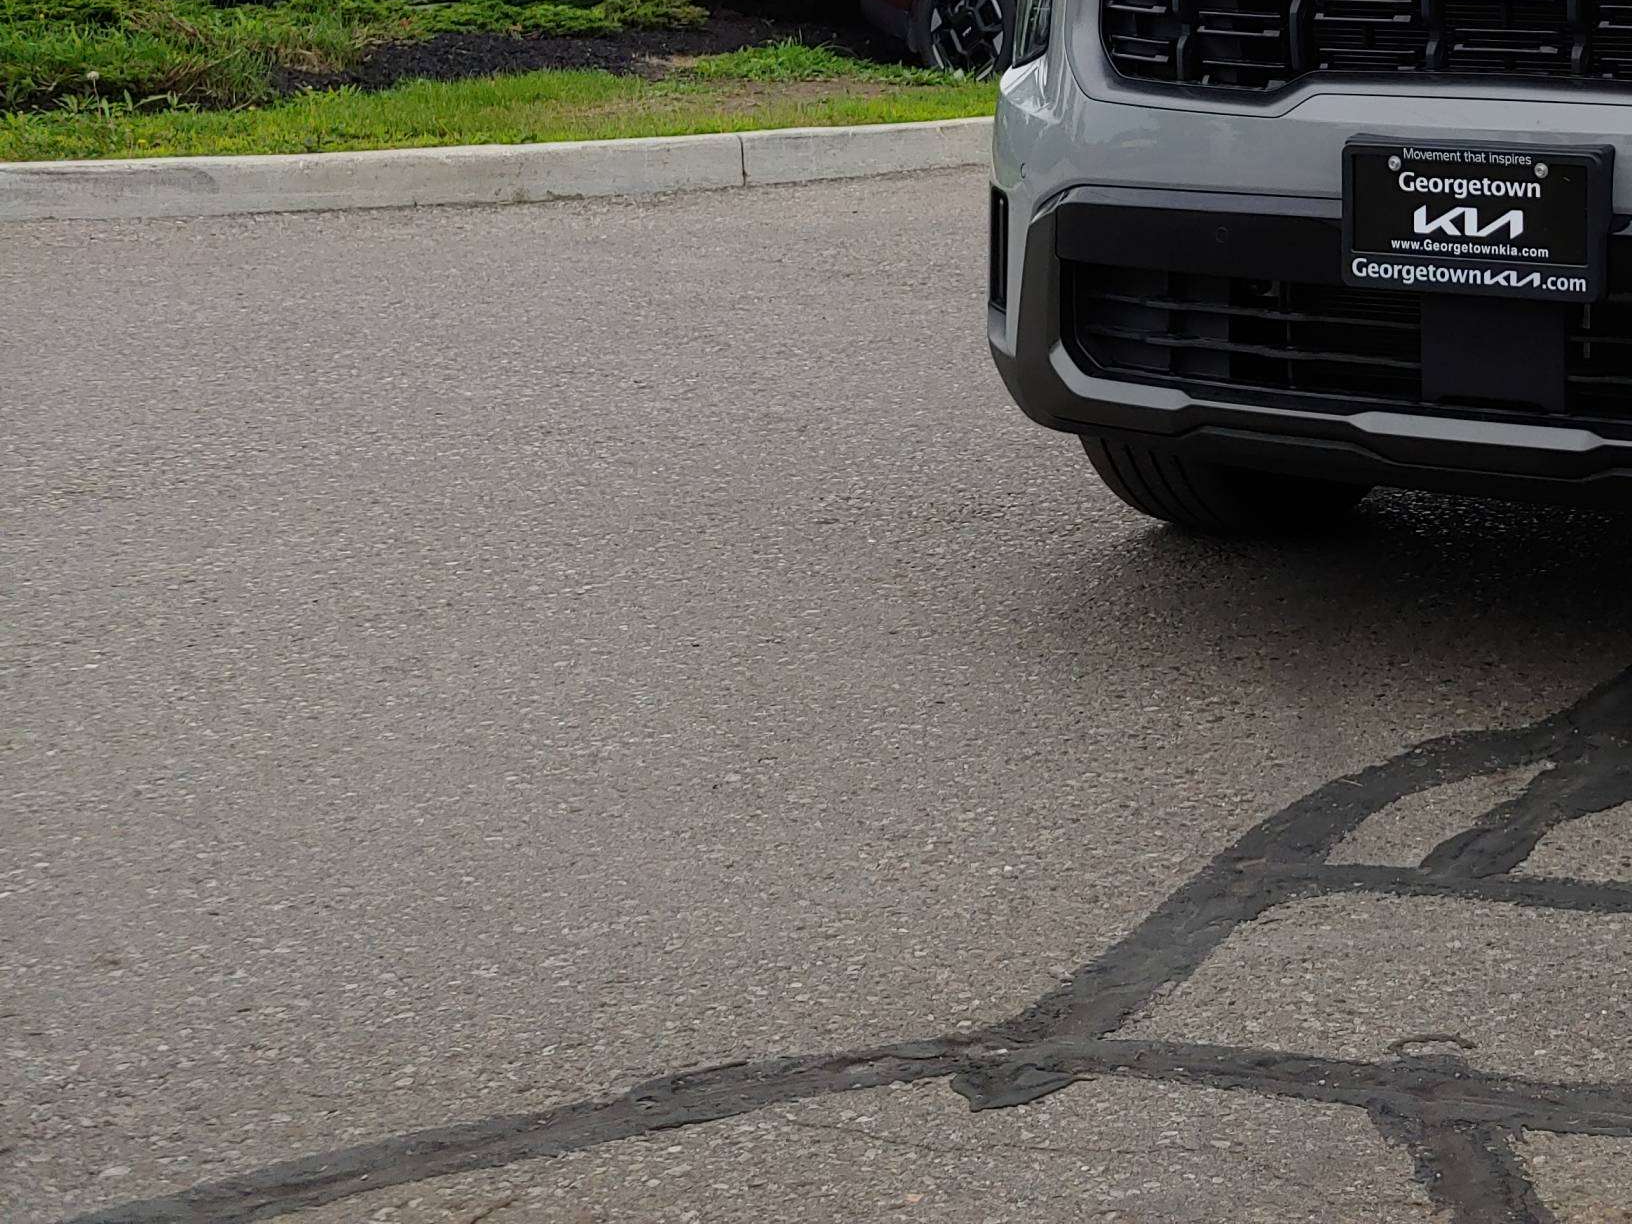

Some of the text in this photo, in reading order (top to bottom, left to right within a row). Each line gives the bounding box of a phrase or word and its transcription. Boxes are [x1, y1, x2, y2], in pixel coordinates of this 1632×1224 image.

[1403, 147, 1532, 166] Movement that inspires
[1398, 171, 1542, 199] Georgetown
[1413, 204, 1524, 240] KIA
[1390, 239, 1549, 259] www.Georgetownkia.com
